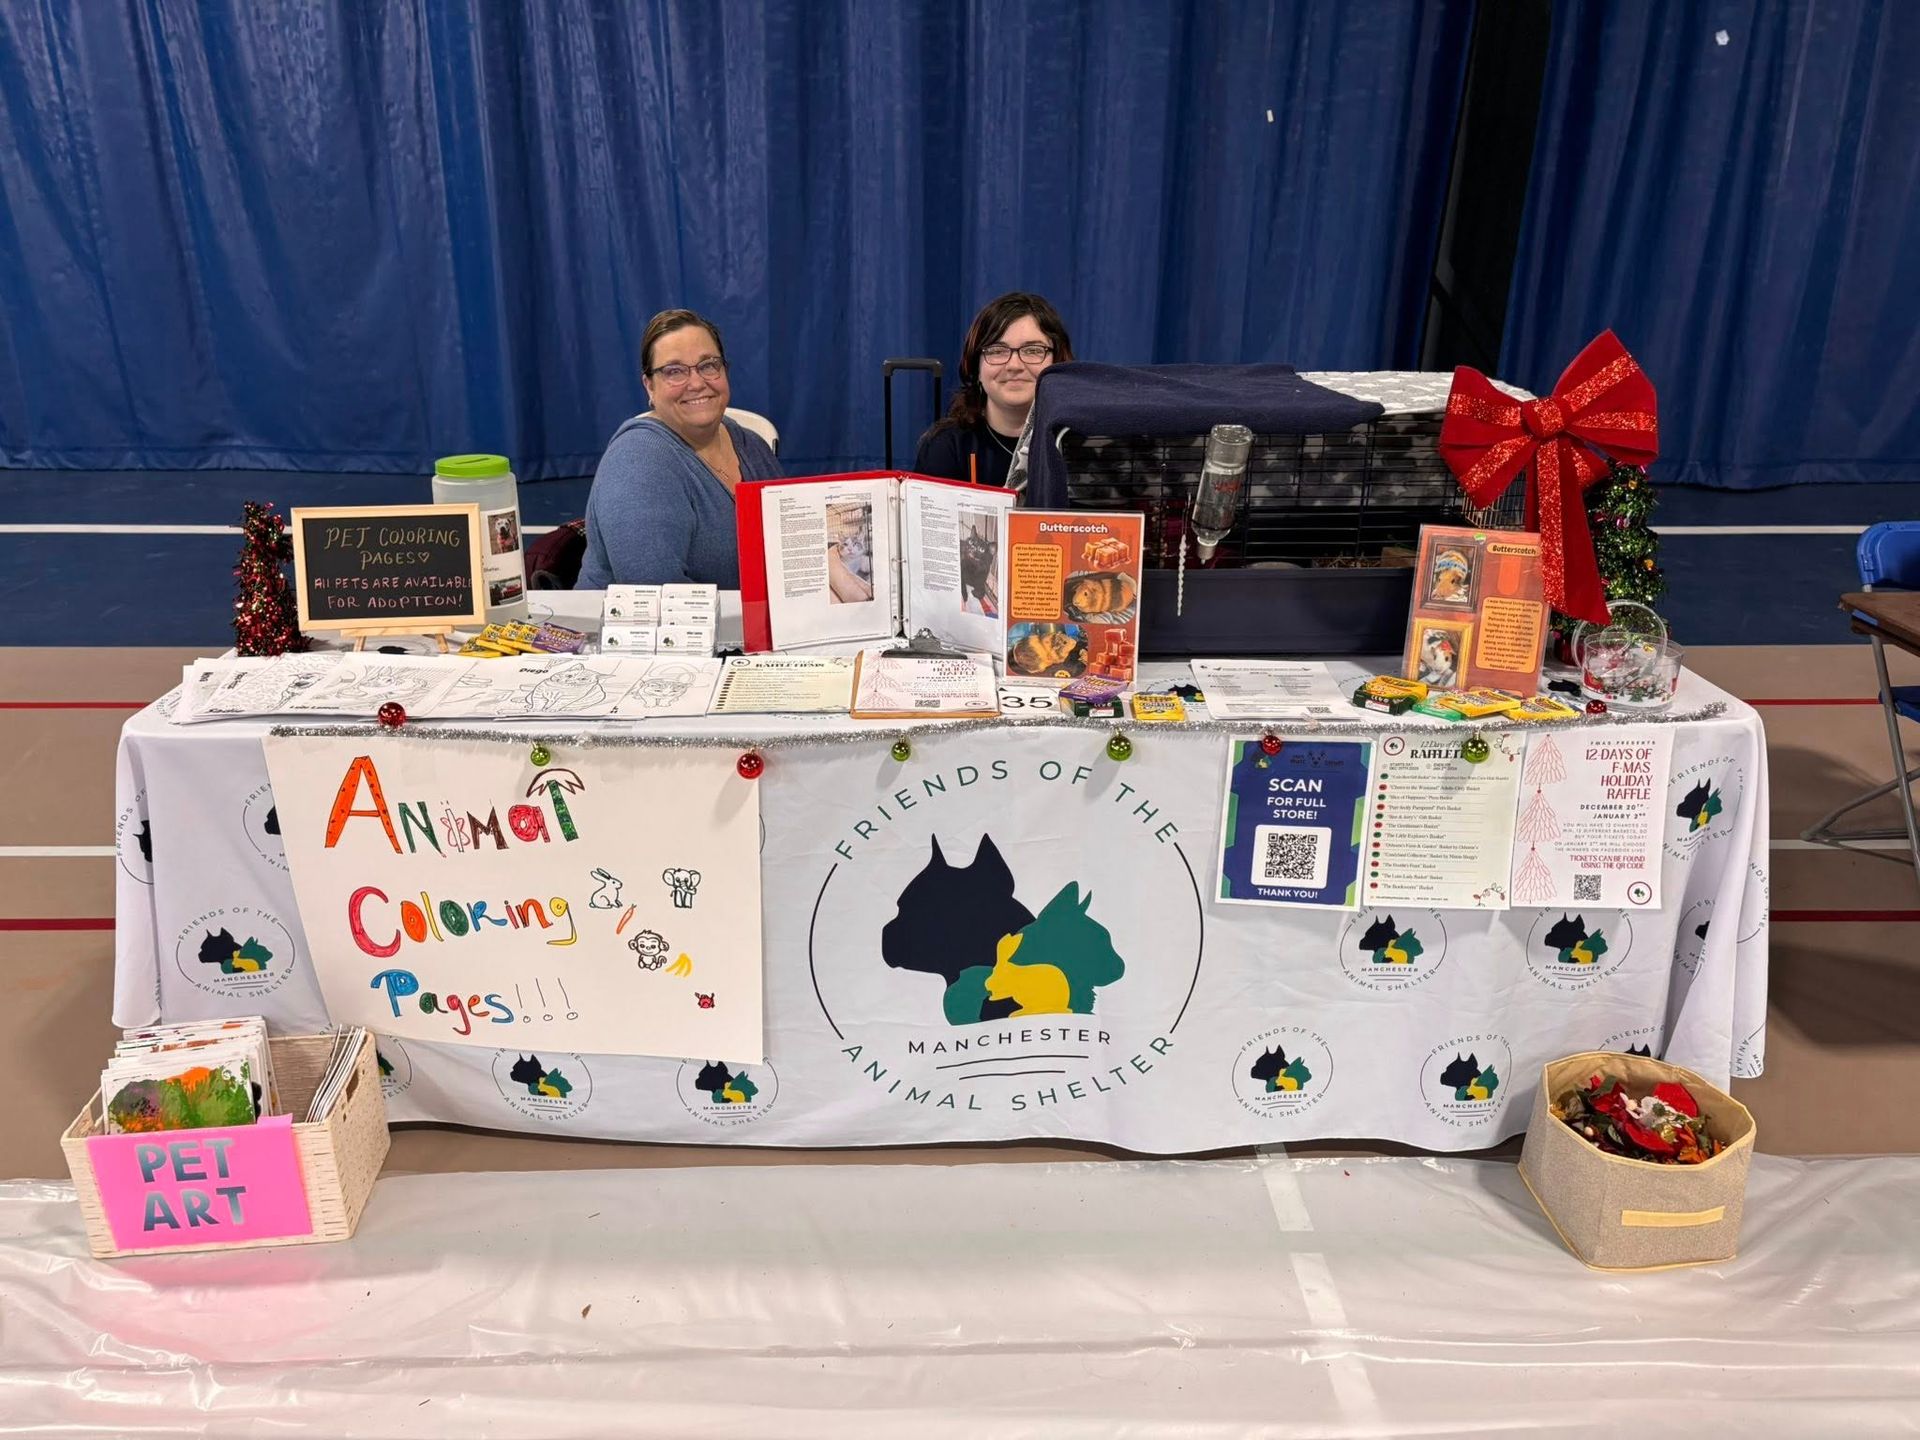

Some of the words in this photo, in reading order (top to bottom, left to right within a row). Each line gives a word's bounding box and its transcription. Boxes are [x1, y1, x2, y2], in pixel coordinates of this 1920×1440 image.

[1040, 522, 1108, 533] Butterscotch
[324, 527, 370, 550] PET
[380, 526, 460, 547] COLORING
[1492, 544, 1536, 555] Butterscotch
[360, 550, 415, 570] PAGES
[336, 578, 368, 590] PETS
[372, 577, 399, 589] ARE
[328, 596, 361, 608] FOR
[1002, 696, 1052, 708] 35
[1636, 748, 1652, 760] OF
[1612, 762, 1650, 773] F-MAS
[1268, 778, 1322, 792] SCAN
[1601, 775, 1653, 786] HOLIDAY
[1267, 797, 1293, 806] FOR
[1296, 798, 1326, 807] FULL
[1607, 788, 1651, 800] RAFFLE
[835, 760, 1009, 861] FRIENDS
[1038, 758, 1094, 787] OF
[1113, 782, 1178, 845] THE
[1273, 810, 1317, 820] STORE!
[1258, 888, 1291, 898] THANK
[1292, 889, 1318, 899] YOU!
[178, 908, 225, 941] FRIENDS
[232, 906, 249, 914] OF
[256, 910, 278, 924] THE
[214, 972, 275, 983] MANCHESTER
[1527, 966, 1564, 990] ANIMAL
[1570, 965, 1618, 991] SHELTER
[1545, 964, 1601, 973] MANCHESTER
[194, 983, 242, 998] ANIMAL
[249, 967, 292, 998] SHELTER
[1343, 970, 1381, 991] ANIMAL
[1387, 968, 1436, 992] SHELTER
[908, 1027, 1112, 1056] MANCHESTER
[1241, 1027, 1286, 1052] FRIENDS
[1311, 1032, 1328, 1047] THE
[1605, 1026, 1657, 1045] FRIENDS
[1432, 1035, 1481, 1056] FRIENDS
[841, 1042, 982, 1112] ANIMAL
[1012, 1036, 1175, 1112] SHELTER
[504, 1096, 543, 1120] ANIMAL
[549, 1102, 588, 1121] SHELTER
[520, 1096, 573, 1105] MANCHESTER
[1238, 1098, 1273, 1119] ANIMAL
[1280, 1093, 1324, 1118] SHELTER
[686, 1106, 726, 1127] ANIMAL
[731, 1103, 774, 1126] SHELTER
[1424, 1101, 1461, 1127] ANIMAL
[136, 1138, 235, 1184] PET
[142, 1183, 248, 1232] ART
